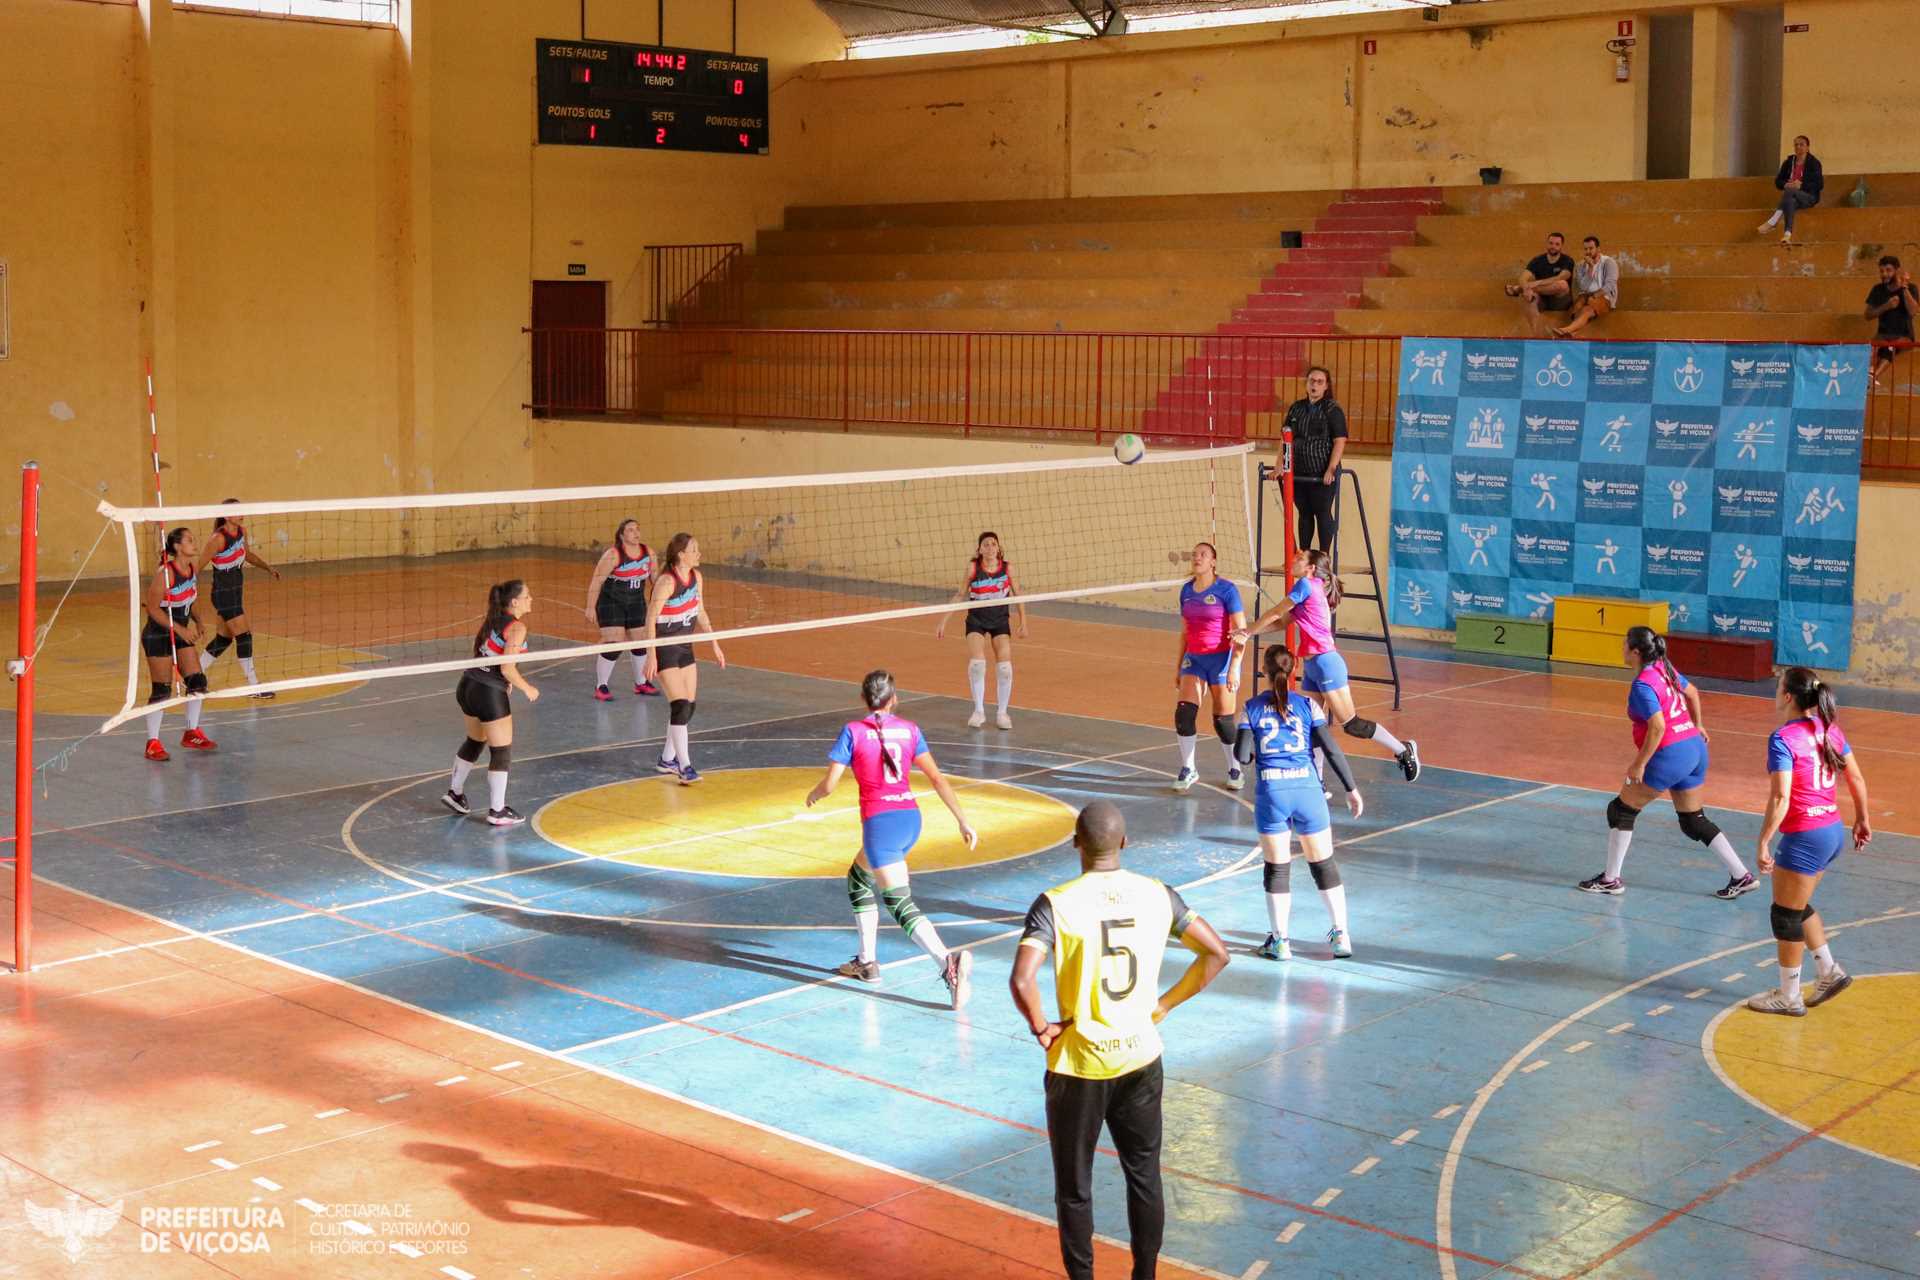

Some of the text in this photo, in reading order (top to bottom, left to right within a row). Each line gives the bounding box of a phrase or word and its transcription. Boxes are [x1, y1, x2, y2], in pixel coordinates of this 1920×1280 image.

[549, 47, 608, 60] SETS/FALTAS
[706, 59, 759, 73] SETS/FALTAS
[584, 68, 590, 82] 1
[643, 75, 674, 87] TEMPO
[734, 80, 743, 95] 0
[548, 105, 611, 119] PONTOS/GOLS
[652, 111, 675, 122] SETS
[705, 116, 762, 128] PONTOS/GOLS
[590, 125, 595, 139] 1
[656, 127, 666, 143] 2
[739, 133, 748, 147] 4
[1596, 607, 1605, 625] 1
[1494, 626, 1505, 644] 2
[1697, 644, 1711, 666] 3
[1259, 717, 1305, 754] 23
[1101, 918, 1137, 1001] 5
